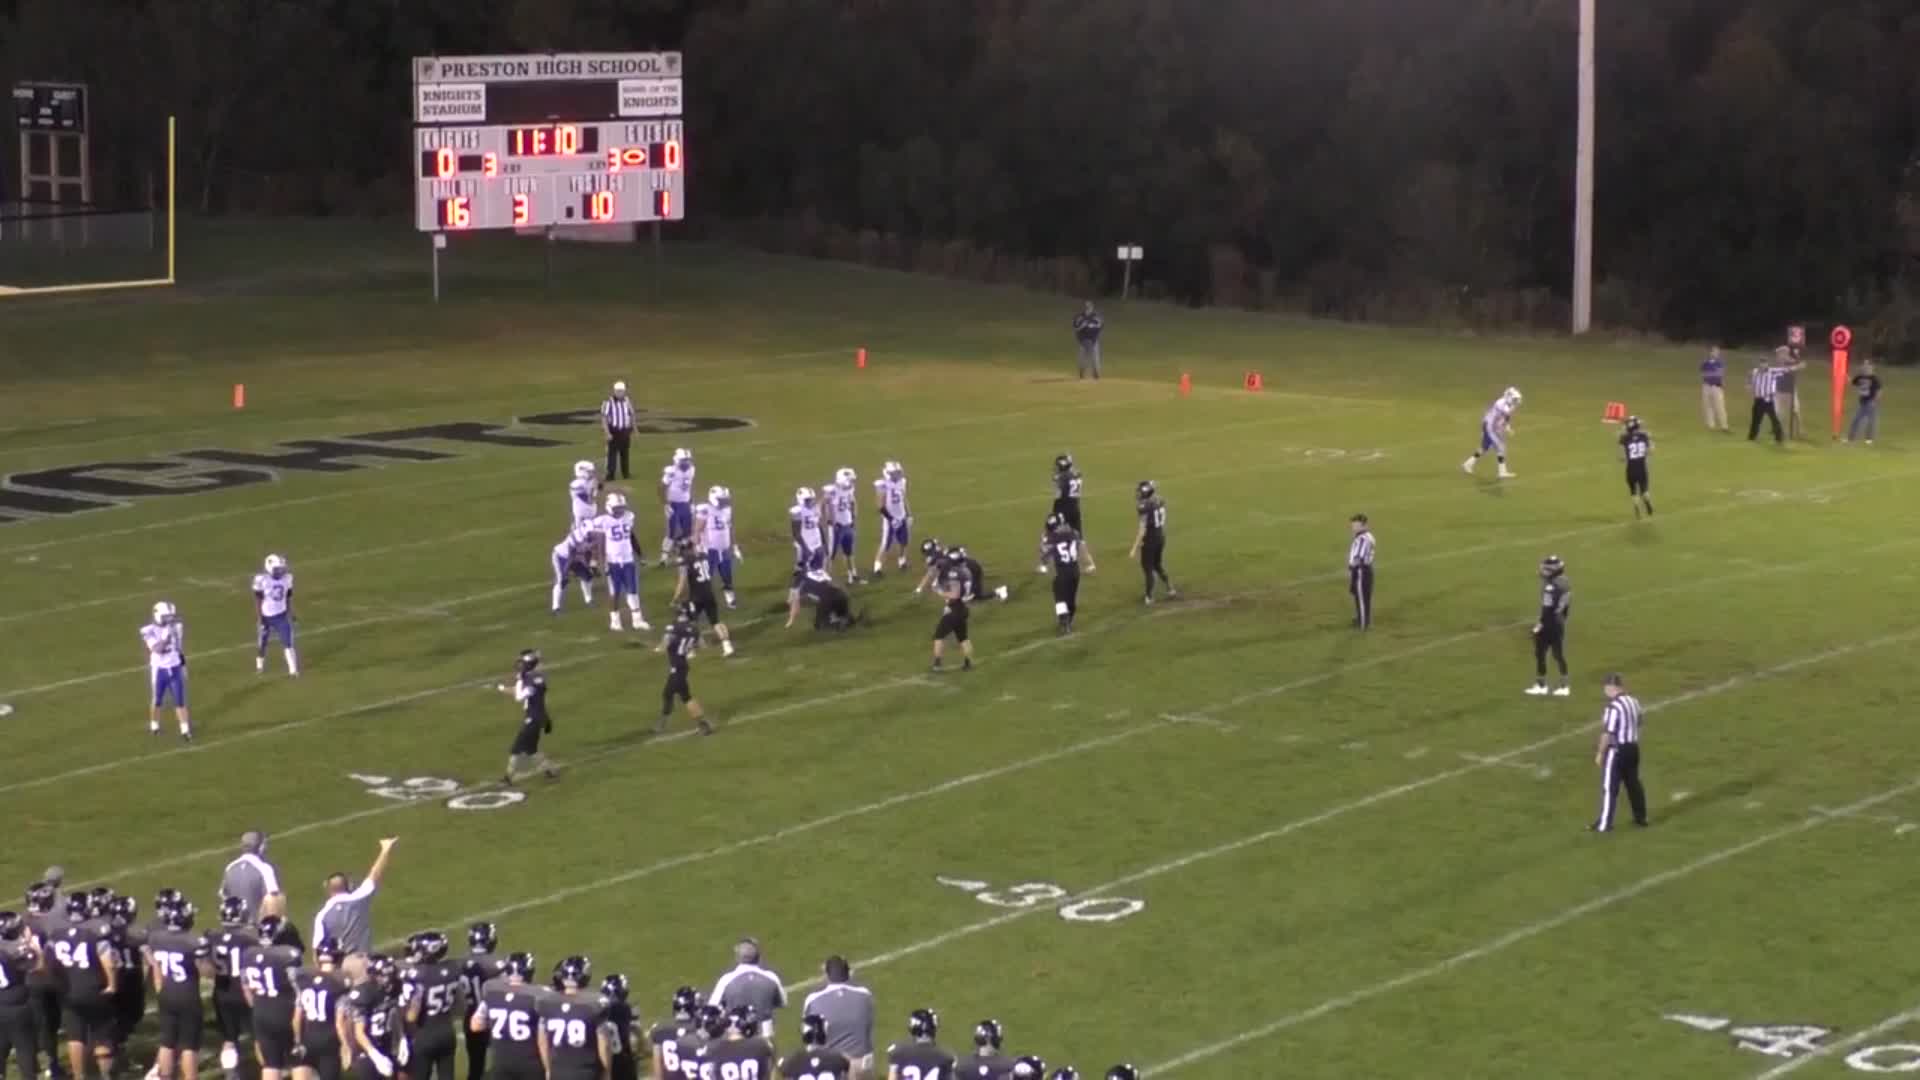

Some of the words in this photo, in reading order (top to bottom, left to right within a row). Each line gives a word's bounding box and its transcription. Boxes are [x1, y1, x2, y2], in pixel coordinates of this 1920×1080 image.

[442, 62, 528, 78] PRESTON
[536, 60, 582, 75] HIGH
[587, 58, 660, 73] SCHOOL
[423, 90, 482, 102] KNIGHTS
[423, 104, 482, 116] STADIUM
[623, 95, 679, 109] KNIGHTS
[516, 125, 577, 156] 11:10
[664, 140, 680, 170] 0
[437, 147, 454, 179] 0
[483, 152, 497, 178] 3
[608, 148, 621, 174] 3
[446, 197, 469, 228] 16
[513, 193, 529, 225] 3
[591, 190, 614, 221] 10
[662, 190, 670, 216] 1
[975, 882, 1146, 923] 30
[54, 940, 90, 969] 64
[153, 950, 188, 983] 75
[488, 1007, 531, 1041] 76
